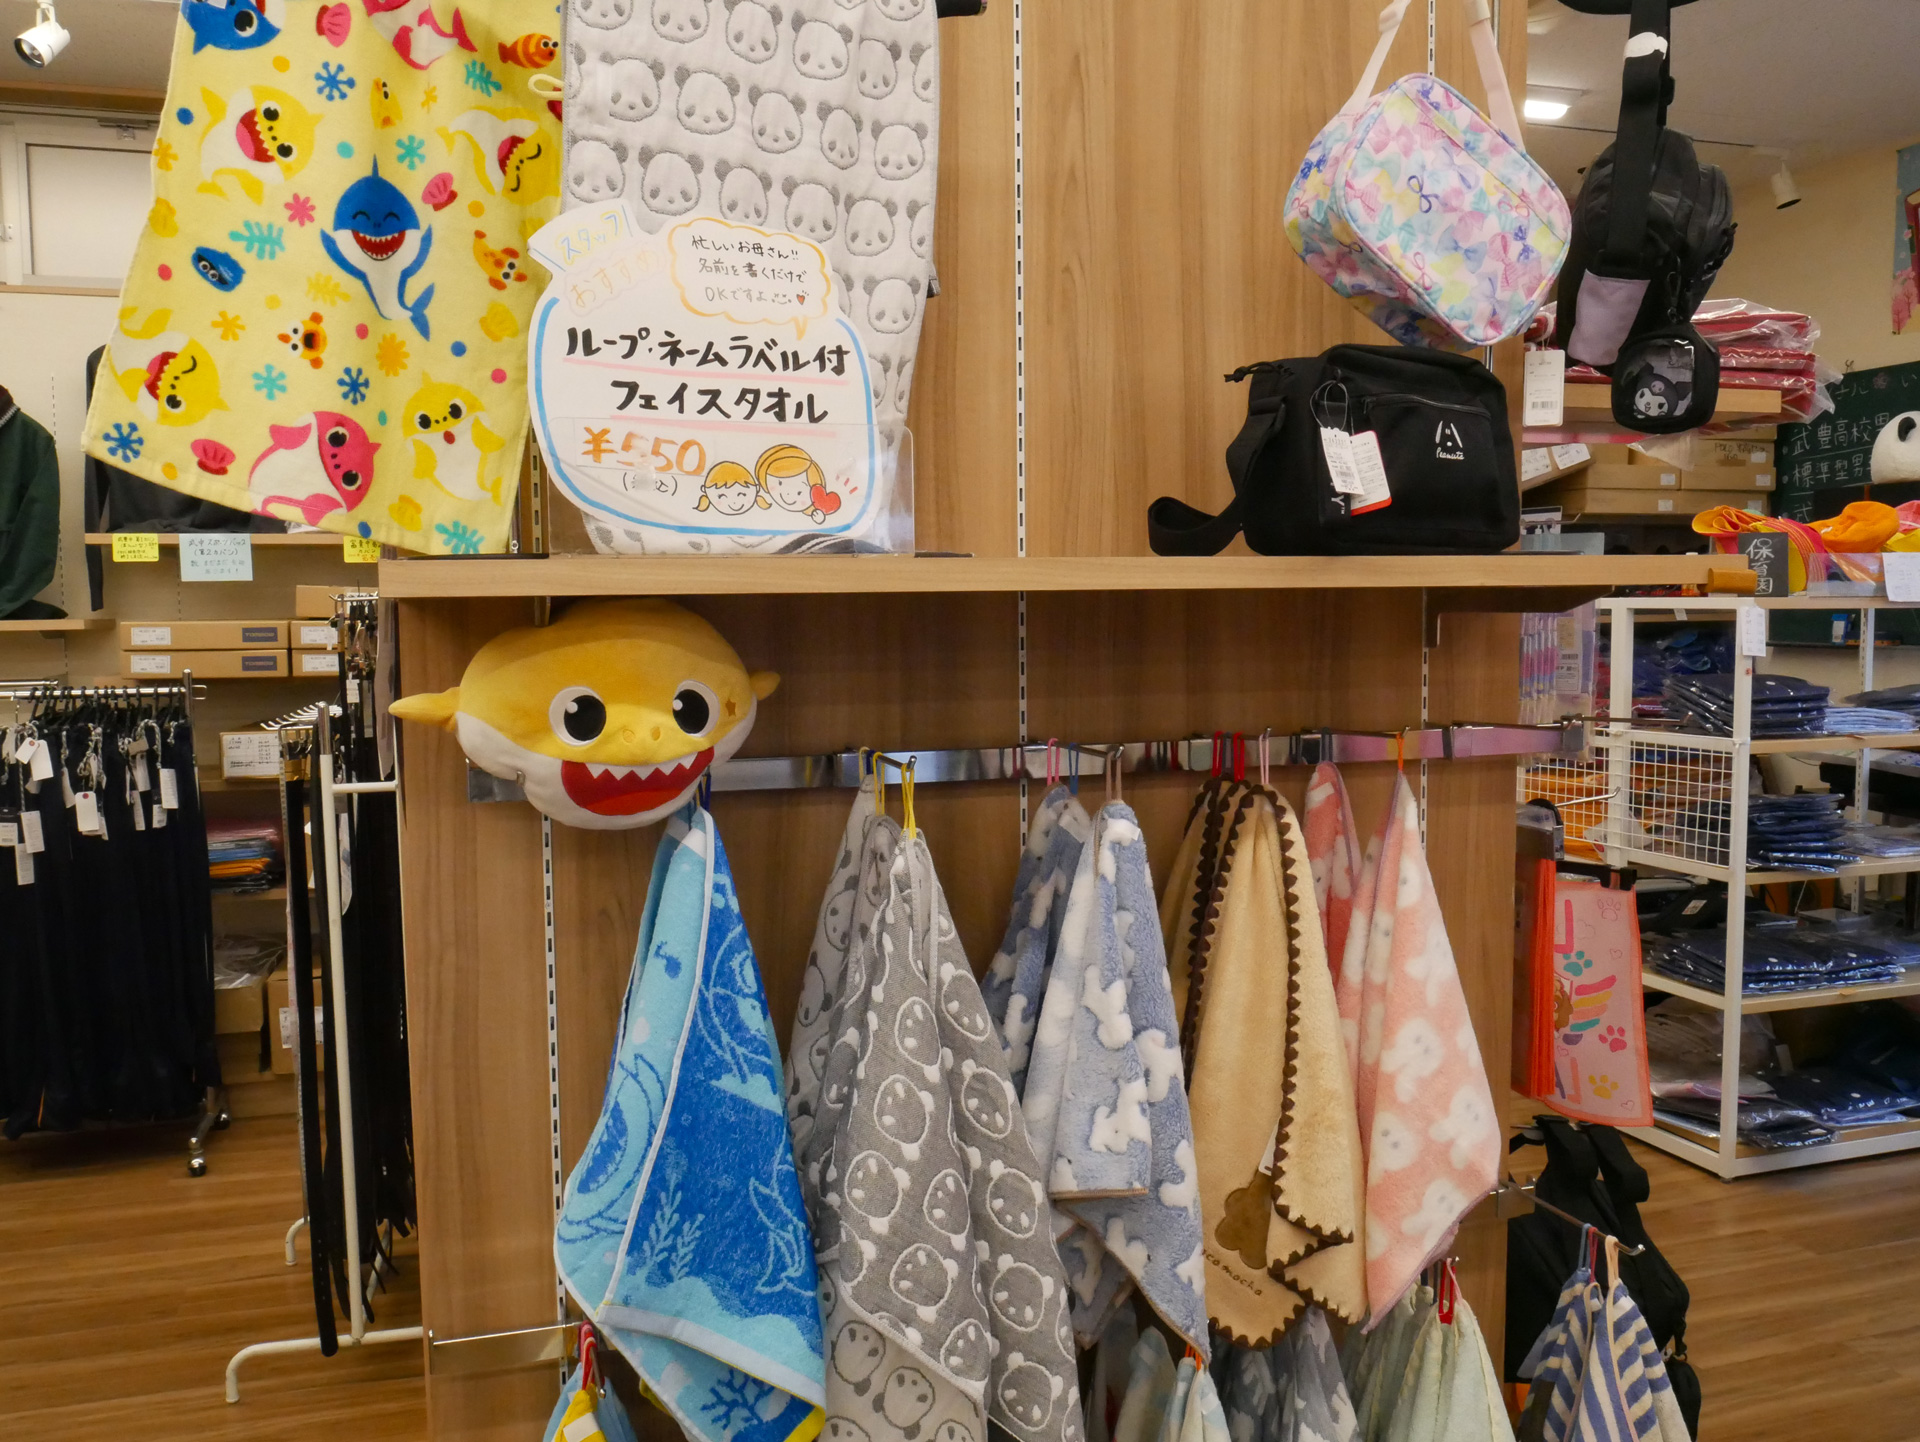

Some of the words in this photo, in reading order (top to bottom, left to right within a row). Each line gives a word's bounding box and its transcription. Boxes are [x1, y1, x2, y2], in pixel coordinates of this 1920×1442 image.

[560, 213, 618, 260] スタッフ
[698, 258, 808, 284] 名前を書くだけで
[610, 380, 829, 423] フェイスタオル
